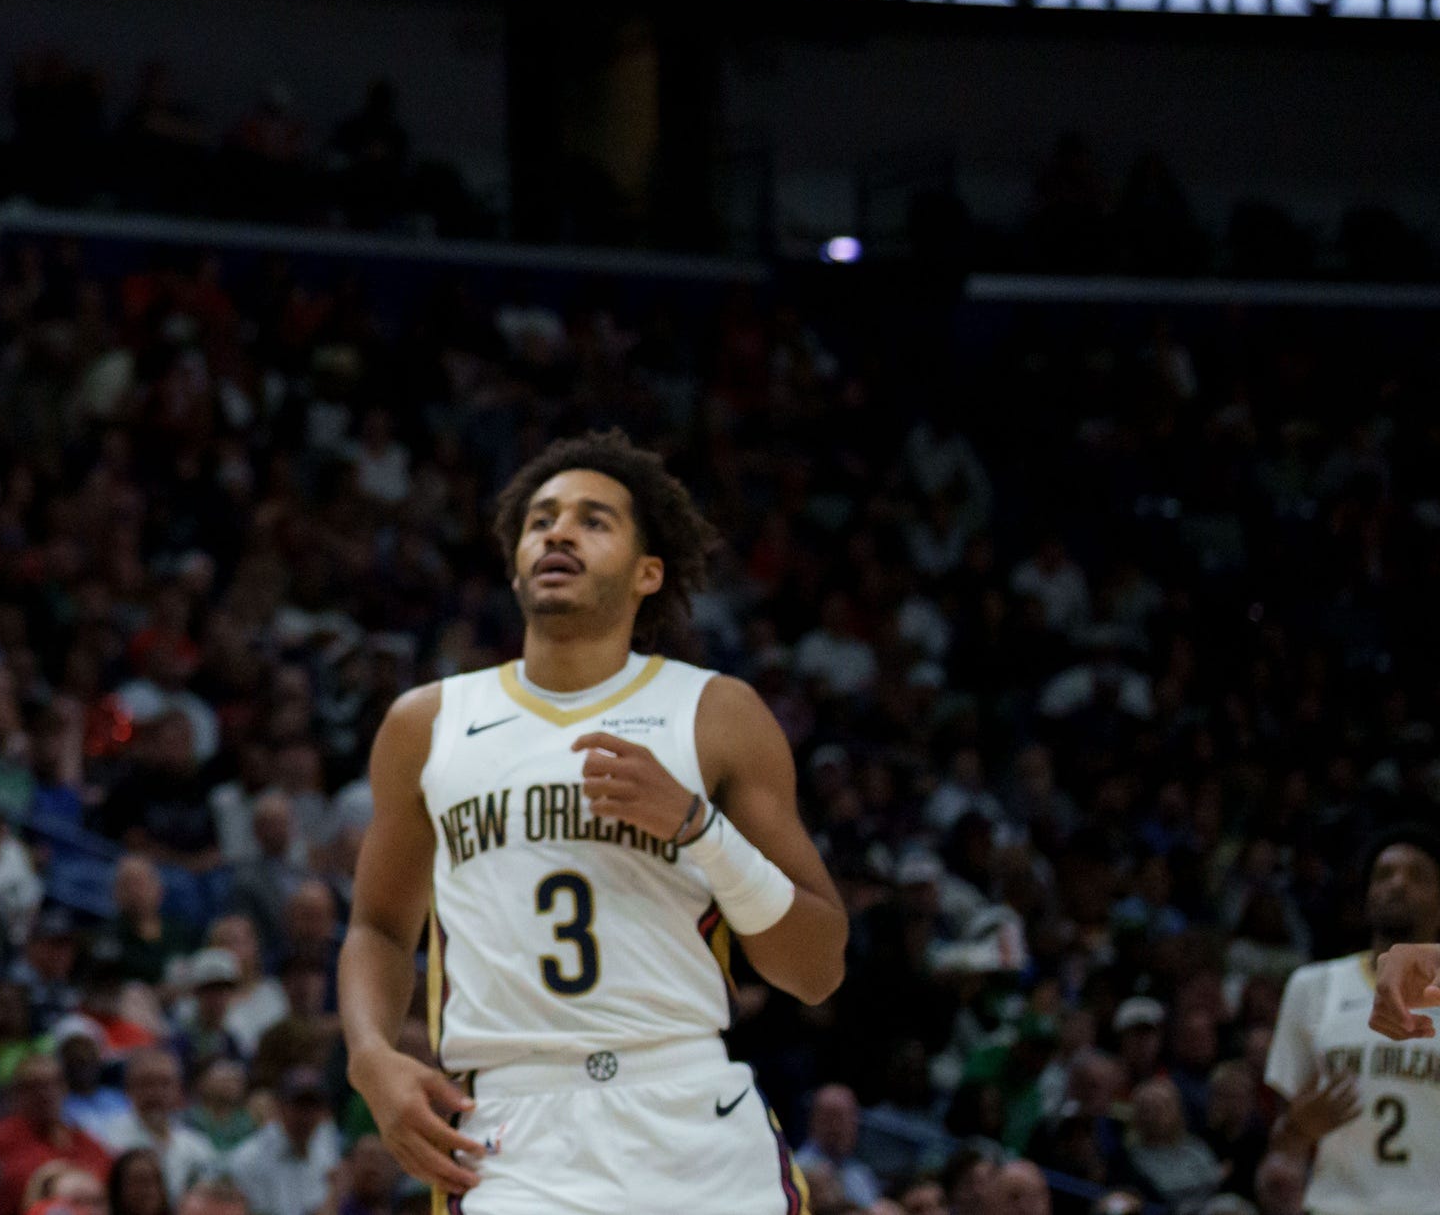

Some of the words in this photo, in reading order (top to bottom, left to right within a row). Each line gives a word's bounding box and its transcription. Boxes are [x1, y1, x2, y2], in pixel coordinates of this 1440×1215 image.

[439, 787, 511, 872] NEW
[535, 869, 600, 998] 3
[1375, 1096, 1408, 1162] 2
